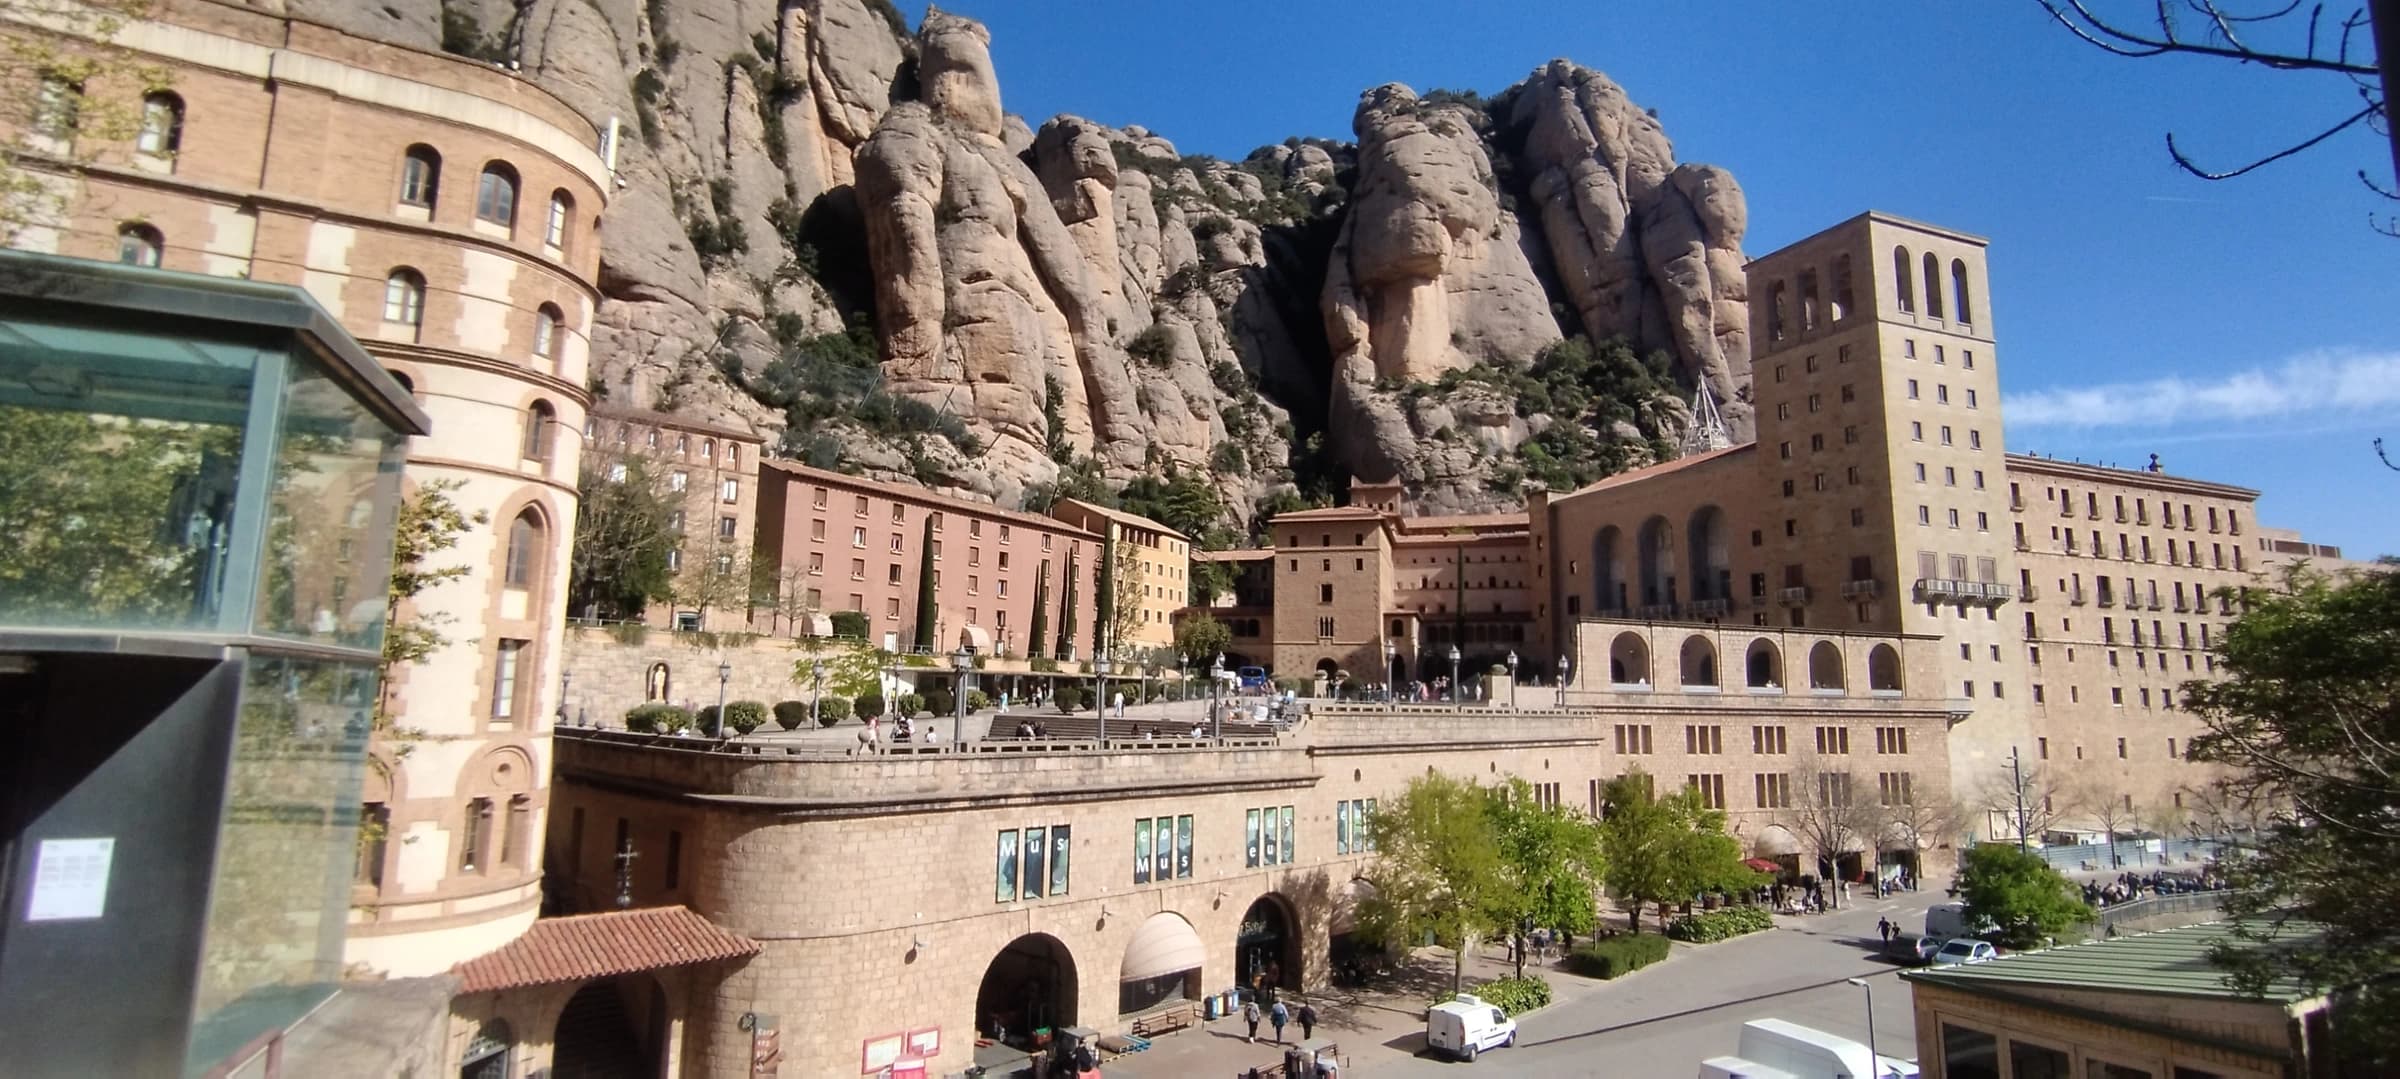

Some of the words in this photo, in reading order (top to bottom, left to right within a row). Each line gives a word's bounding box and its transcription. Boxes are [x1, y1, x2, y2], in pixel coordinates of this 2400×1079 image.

[1000, 838, 1065, 857] Mus
[1249, 844, 1274, 858] eu
[1136, 855, 1188, 874] Mus
